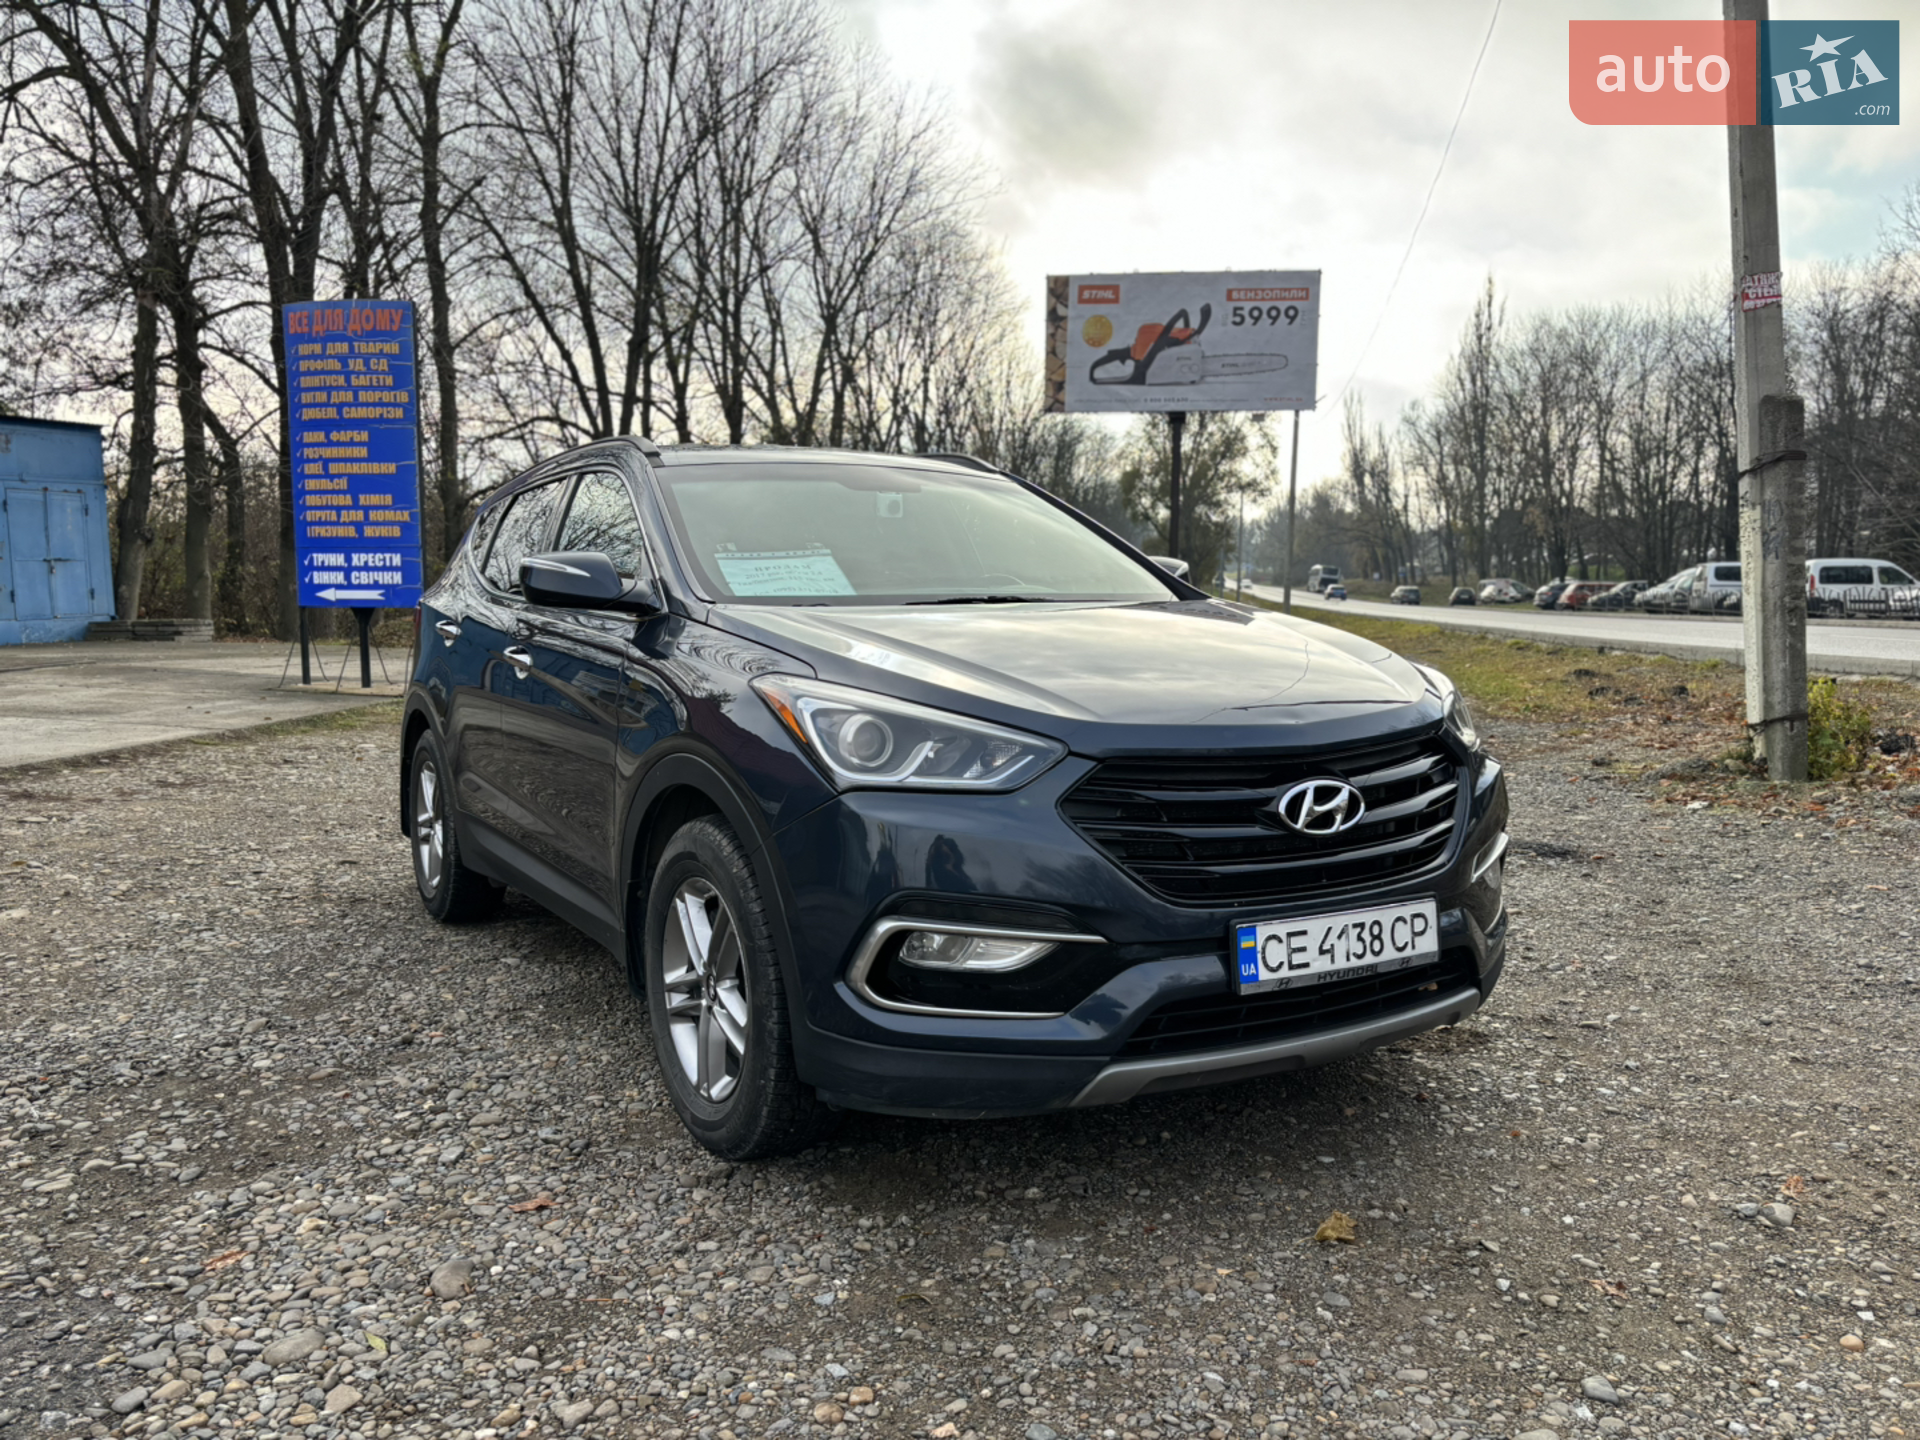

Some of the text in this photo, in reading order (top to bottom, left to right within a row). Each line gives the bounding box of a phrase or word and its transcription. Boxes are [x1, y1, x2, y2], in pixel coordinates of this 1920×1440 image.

[1082, 289, 1116, 299] STIHL
[1231, 289, 1307, 300] БЕНЗОПИЛИ
[288, 308, 404, 337] ВСЕ ДЛЯ ДОМУ
[1231, 305, 1300, 327] 5999
[326, 342, 349, 355] ДЛЯ
[353, 341, 400, 354] ТВАРИН
[299, 359, 342, 372] ПРОФІЛЬ
[370, 358, 389, 371] СД
[300, 375, 393, 388] ПЛІНТУСИ, БАГЕТИ
[330, 391, 353, 404] ДЛЯ
[358, 391, 409, 403] ПОРОГІВ
[301, 407, 403, 421] ДЮБЕЛІ, САМОРІЗИ
[303, 430, 369, 443] ЛАКИ, ФАРБИ
[303, 446, 368, 459] РОЗЧИННИКИ
[328, 463, 397, 475] ШПАКЛІВКИ
[304, 476, 348, 490] ЕМУЛЬСІЇ
[305, 494, 393, 506] ПОБУТОВА ХІМІЯ
[306, 510, 411, 523] ОТРУТА ДЛЯ КОМАХ
[312, 526, 358, 538] ГРИЗУНІВ,
[363, 525, 401, 538] ЖУКІВ
[312, 553, 402, 568] ТРУНИ, ХРЕСТИ
[754, 564, 812, 572] ПРОДАМ
[313, 571, 402, 586] ВІНКИ, СВІЧКИ
[1260, 912, 1429, 973] CE 4138 CP
[1242, 962, 1257, 976] UA
[1317, 964, 1378, 983] HYUNDAI
